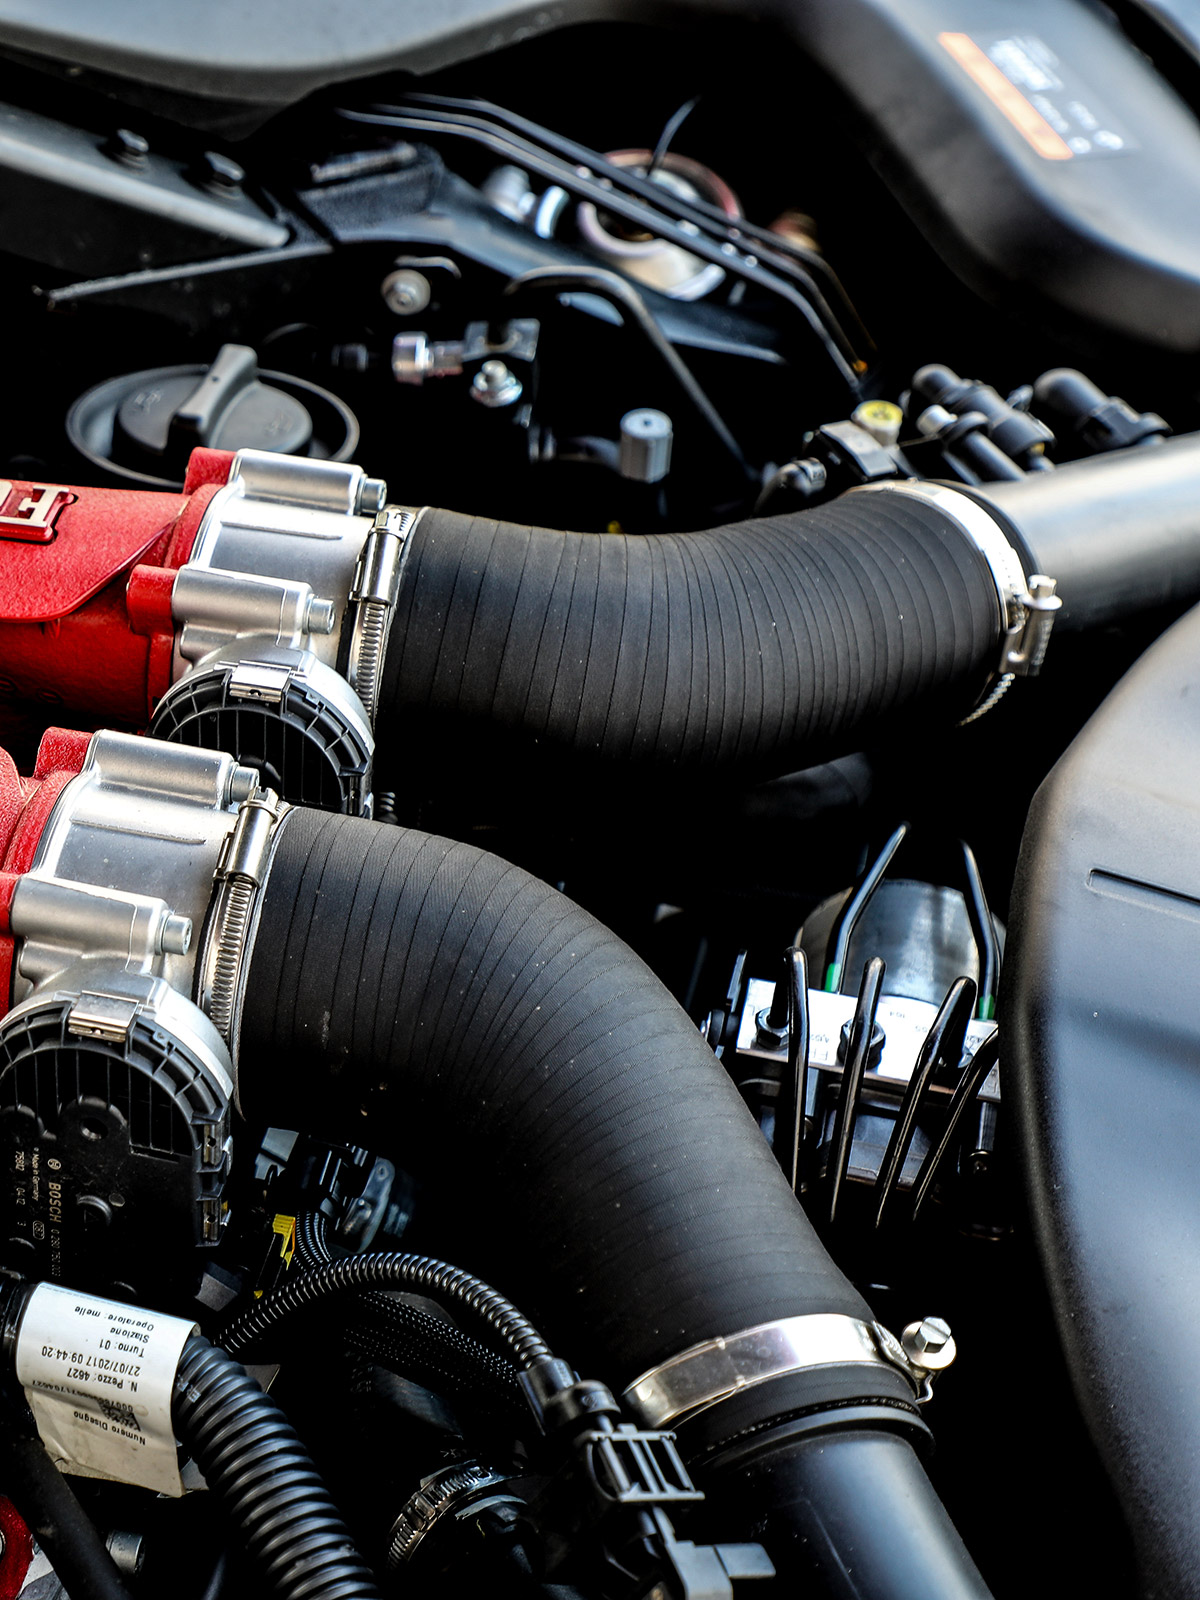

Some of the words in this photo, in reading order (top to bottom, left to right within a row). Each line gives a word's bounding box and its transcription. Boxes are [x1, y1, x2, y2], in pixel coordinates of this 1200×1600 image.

[31, 1175, 40, 1201] Germany
[48, 1182, 62, 1223] BOSCH
[99, 1339, 111, 1350] 01
[41, 1346, 83, 1364] 09:44:20
[67, 1367, 90, 1381] 4627
[86, 1356, 141, 1377] 27/07/2017
[94, 1373, 124, 1389] Pezzo:
[73, 1410, 108, 1431] Disegno
[112, 1426, 146, 1446] Numero
